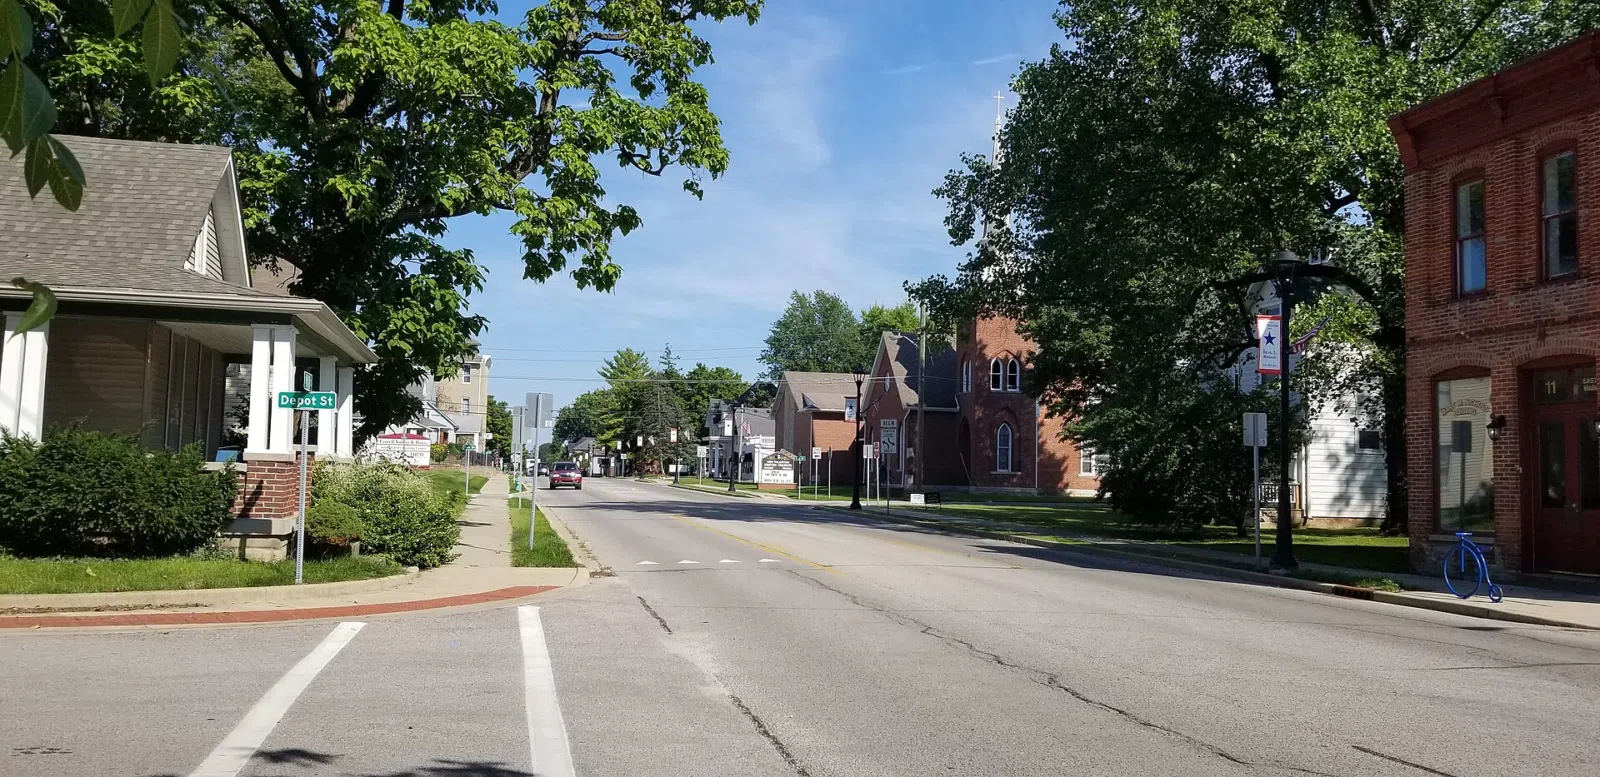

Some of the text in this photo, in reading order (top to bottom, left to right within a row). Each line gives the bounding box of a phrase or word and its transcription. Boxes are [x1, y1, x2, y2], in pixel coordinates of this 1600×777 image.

[1545, 380, 1556, 394] 11
[281, 395, 333, 408] Depot St
